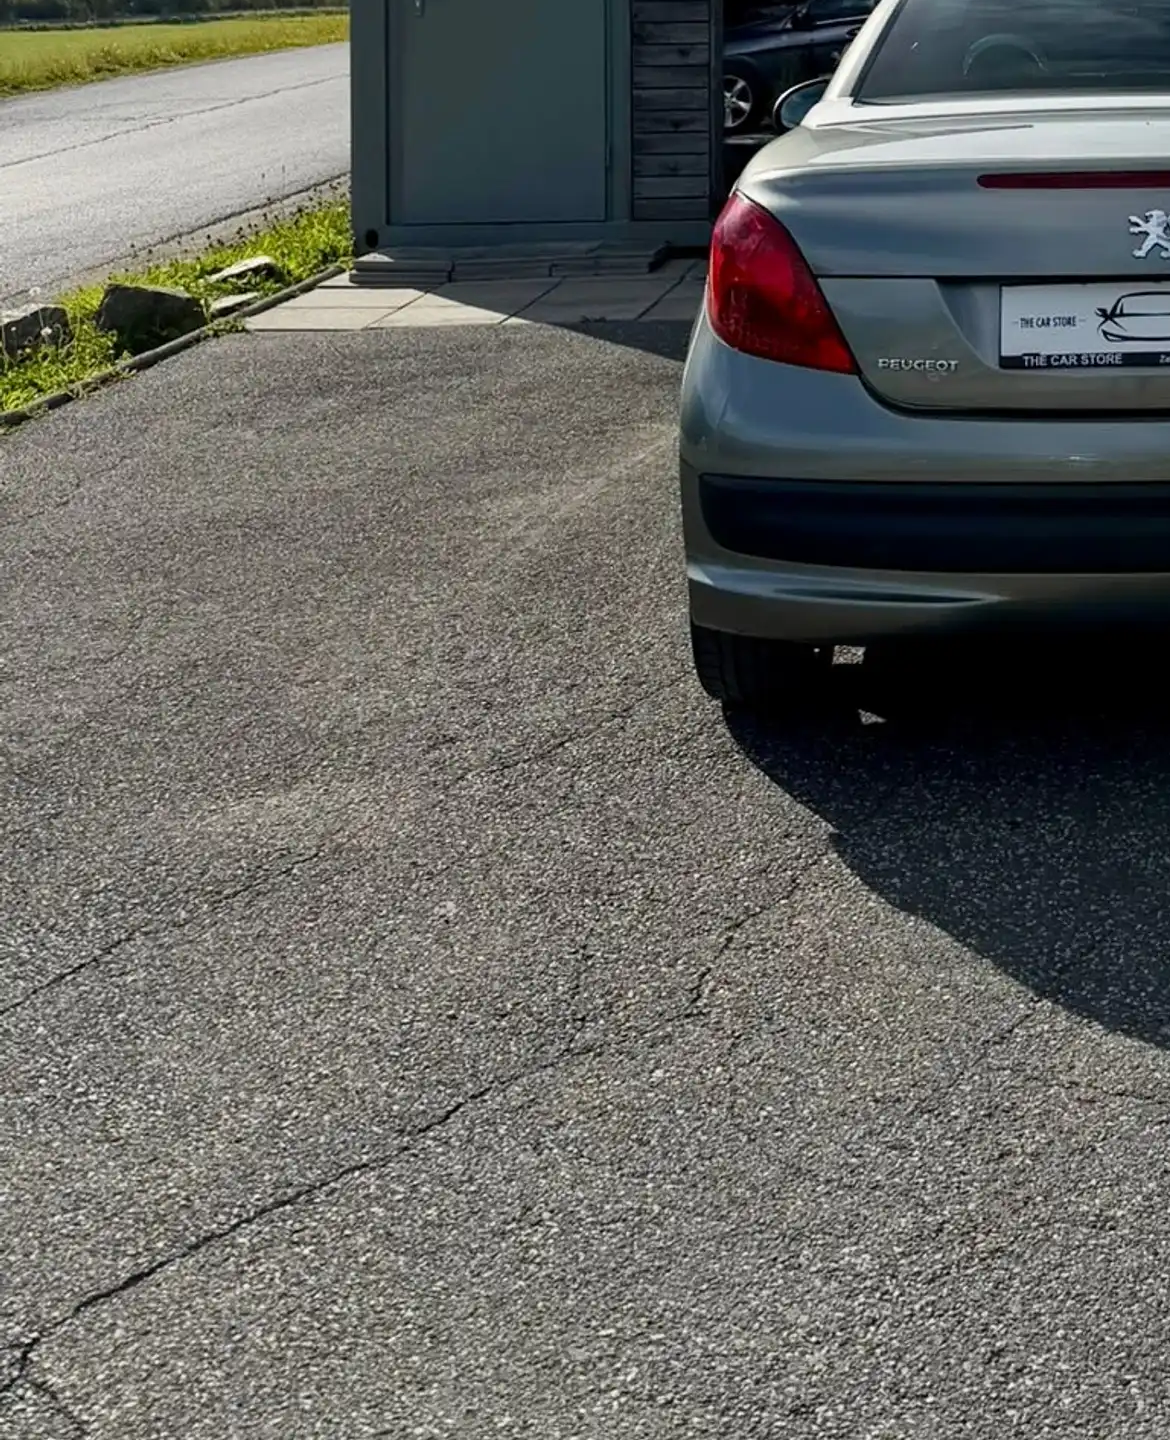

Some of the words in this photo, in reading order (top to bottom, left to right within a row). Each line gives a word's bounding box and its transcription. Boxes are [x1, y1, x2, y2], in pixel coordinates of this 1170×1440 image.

[878, 358, 960, 372] PEUGEOT
[1022, 355, 1049, 367] THE
[1050, 354, 1079, 366] CAR
[1080, 352, 1124, 365] STORE
